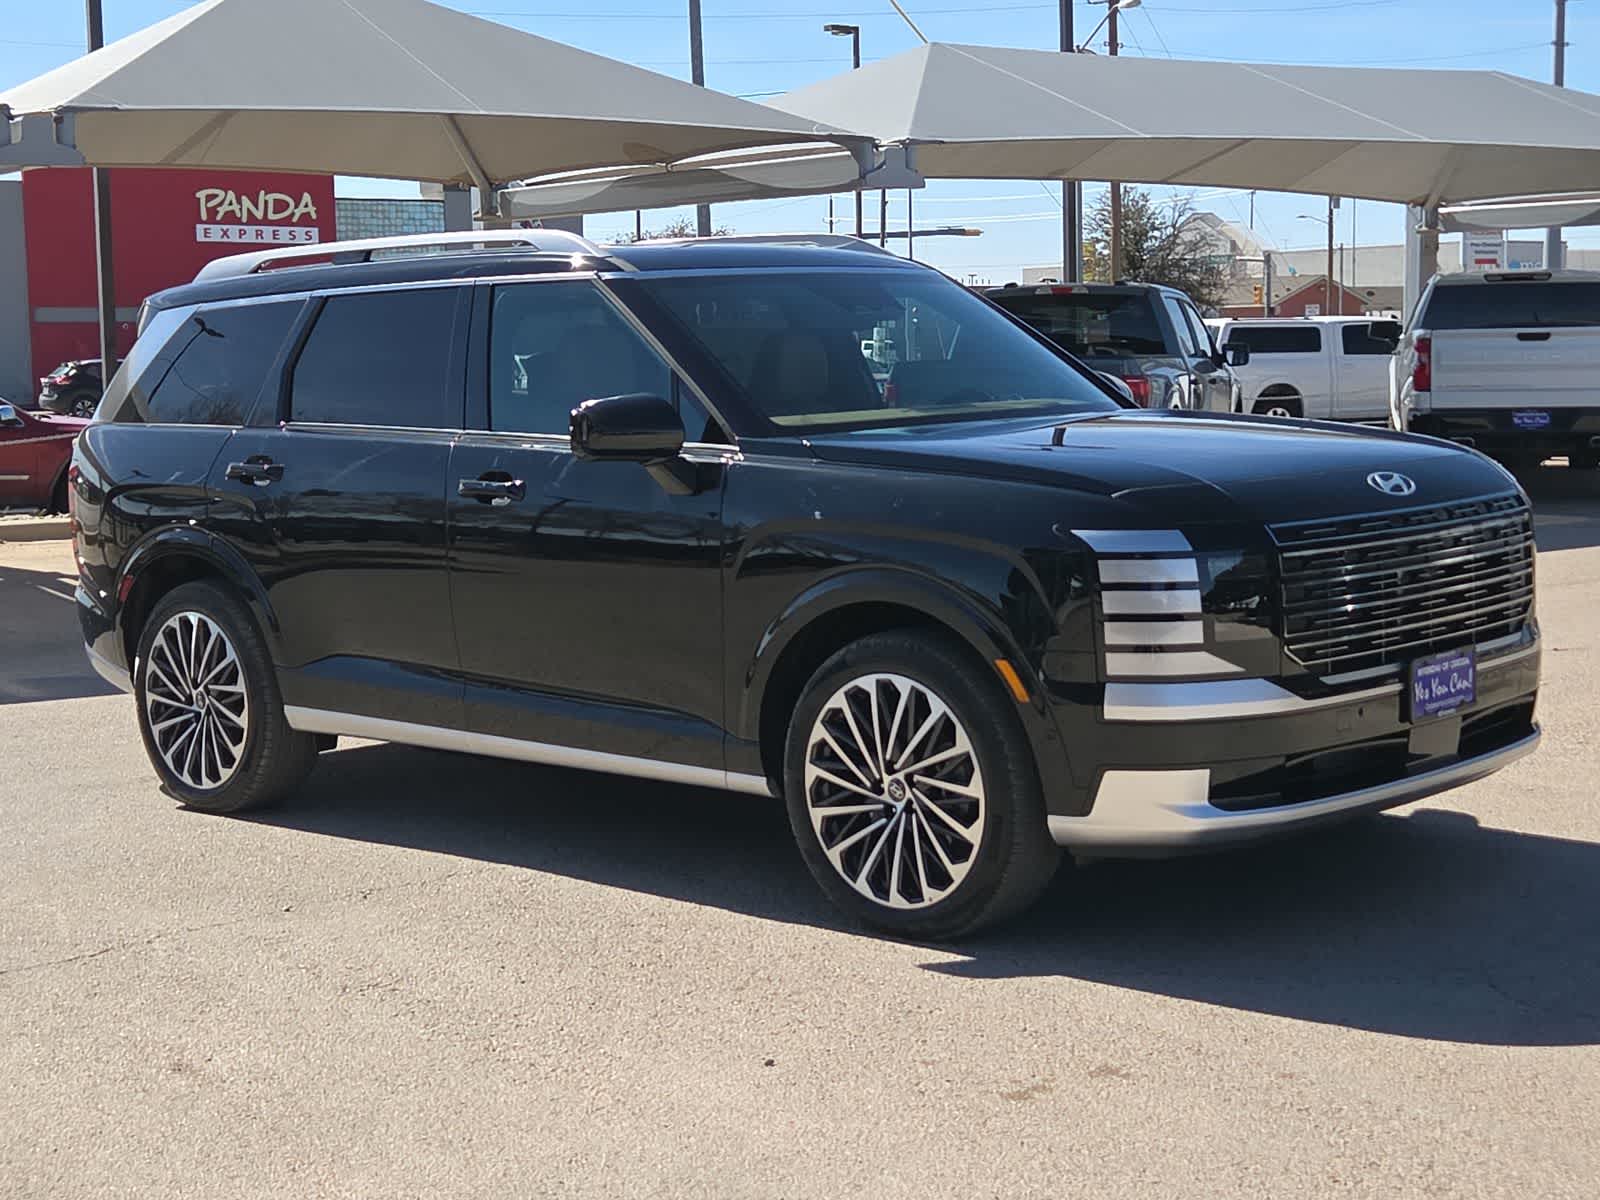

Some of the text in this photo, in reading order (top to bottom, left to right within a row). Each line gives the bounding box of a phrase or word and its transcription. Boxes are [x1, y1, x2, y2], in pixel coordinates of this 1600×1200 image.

[195, 188, 317, 223] PANDA
[203, 227, 313, 241] EXPRESS
[1414, 681, 1430, 703] Yes
[1431, 677, 1448, 699] You
[1450, 667, 1472, 693] Can!
